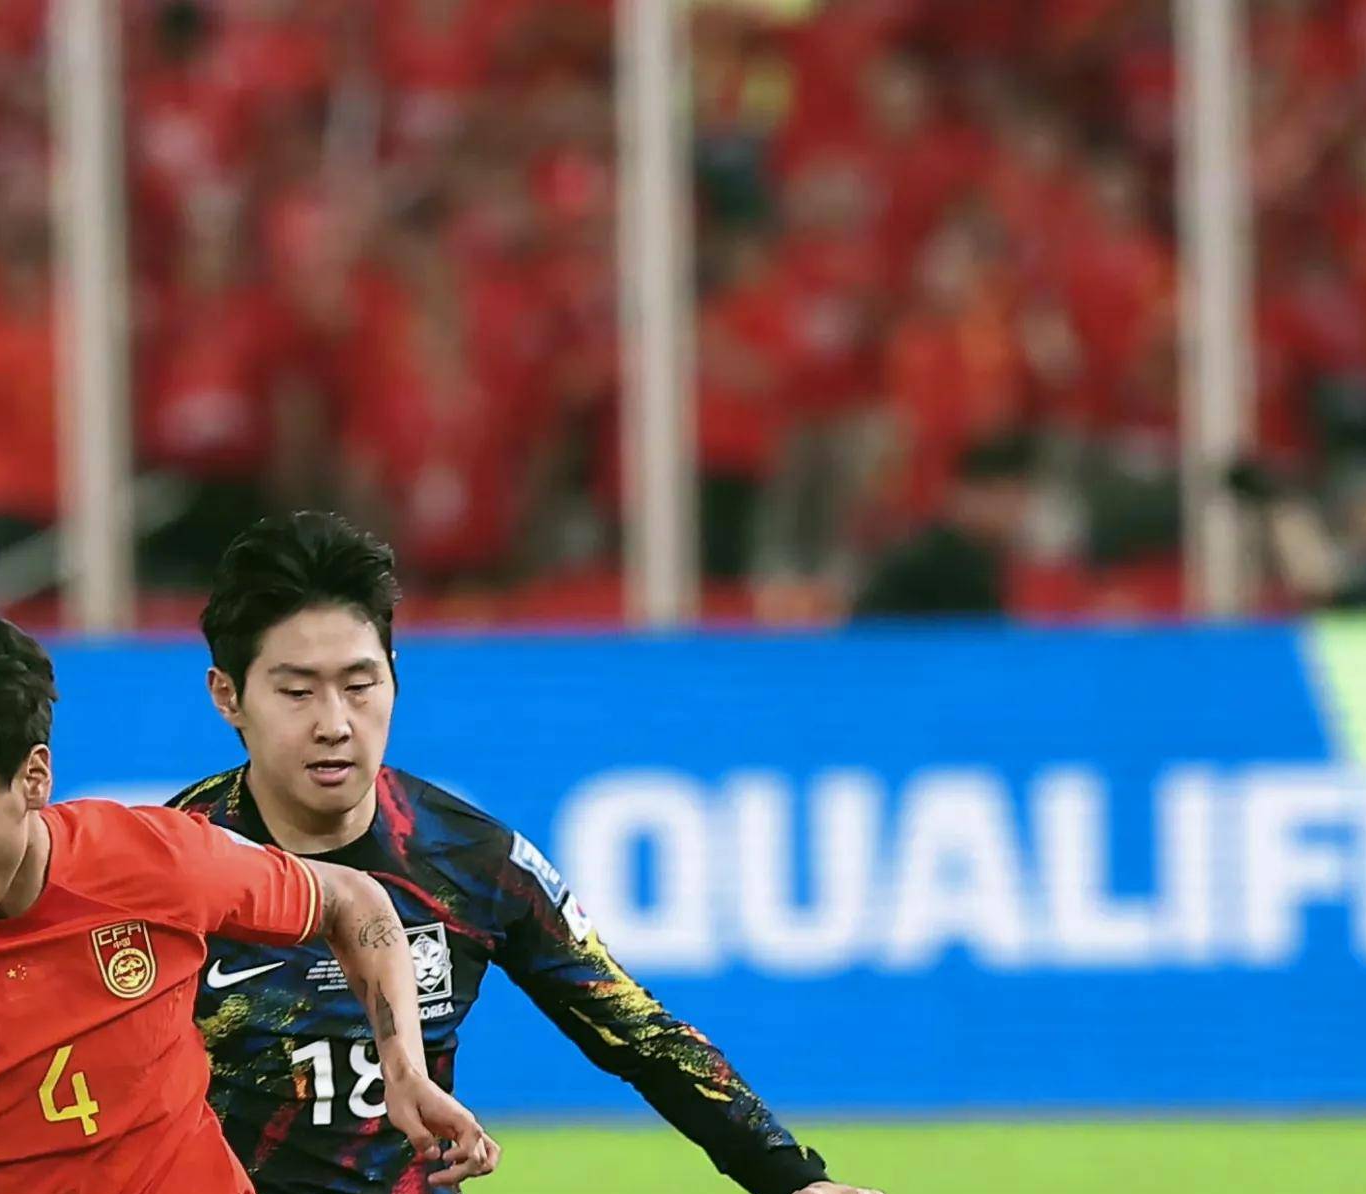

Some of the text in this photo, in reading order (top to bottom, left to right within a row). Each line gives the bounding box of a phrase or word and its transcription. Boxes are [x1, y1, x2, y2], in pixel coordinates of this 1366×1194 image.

[98, 922, 142, 946] CFA
[419, 1001, 455, 1020] OREA
[38, 1044, 99, 1136] 4
